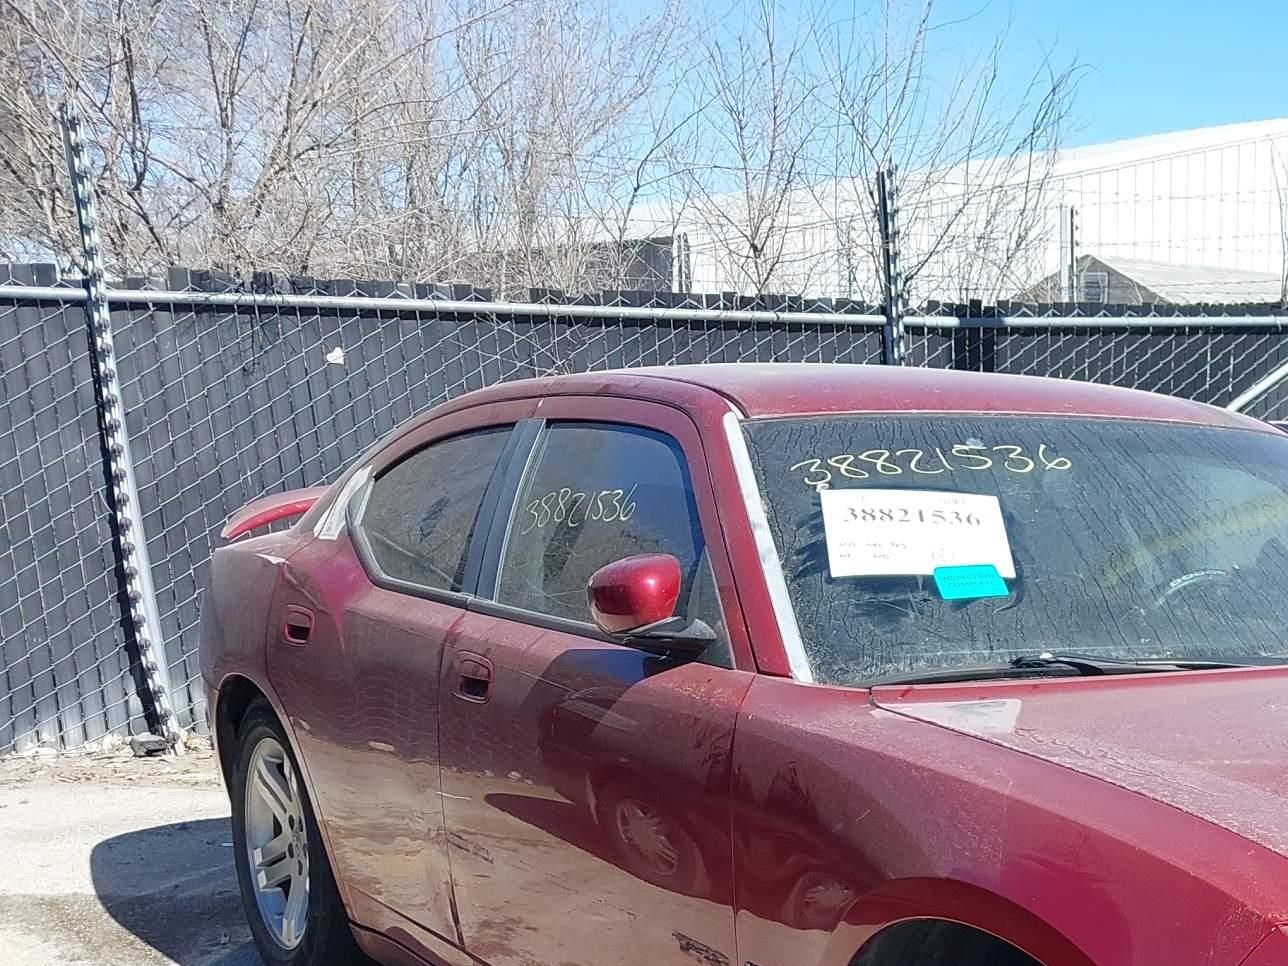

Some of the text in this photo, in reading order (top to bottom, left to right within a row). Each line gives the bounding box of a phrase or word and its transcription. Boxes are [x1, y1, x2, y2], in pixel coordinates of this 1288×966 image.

[790, 444, 1072, 485] 38821536
[521, 482, 638, 535] 38821536
[844, 507, 982, 526] 38821536
